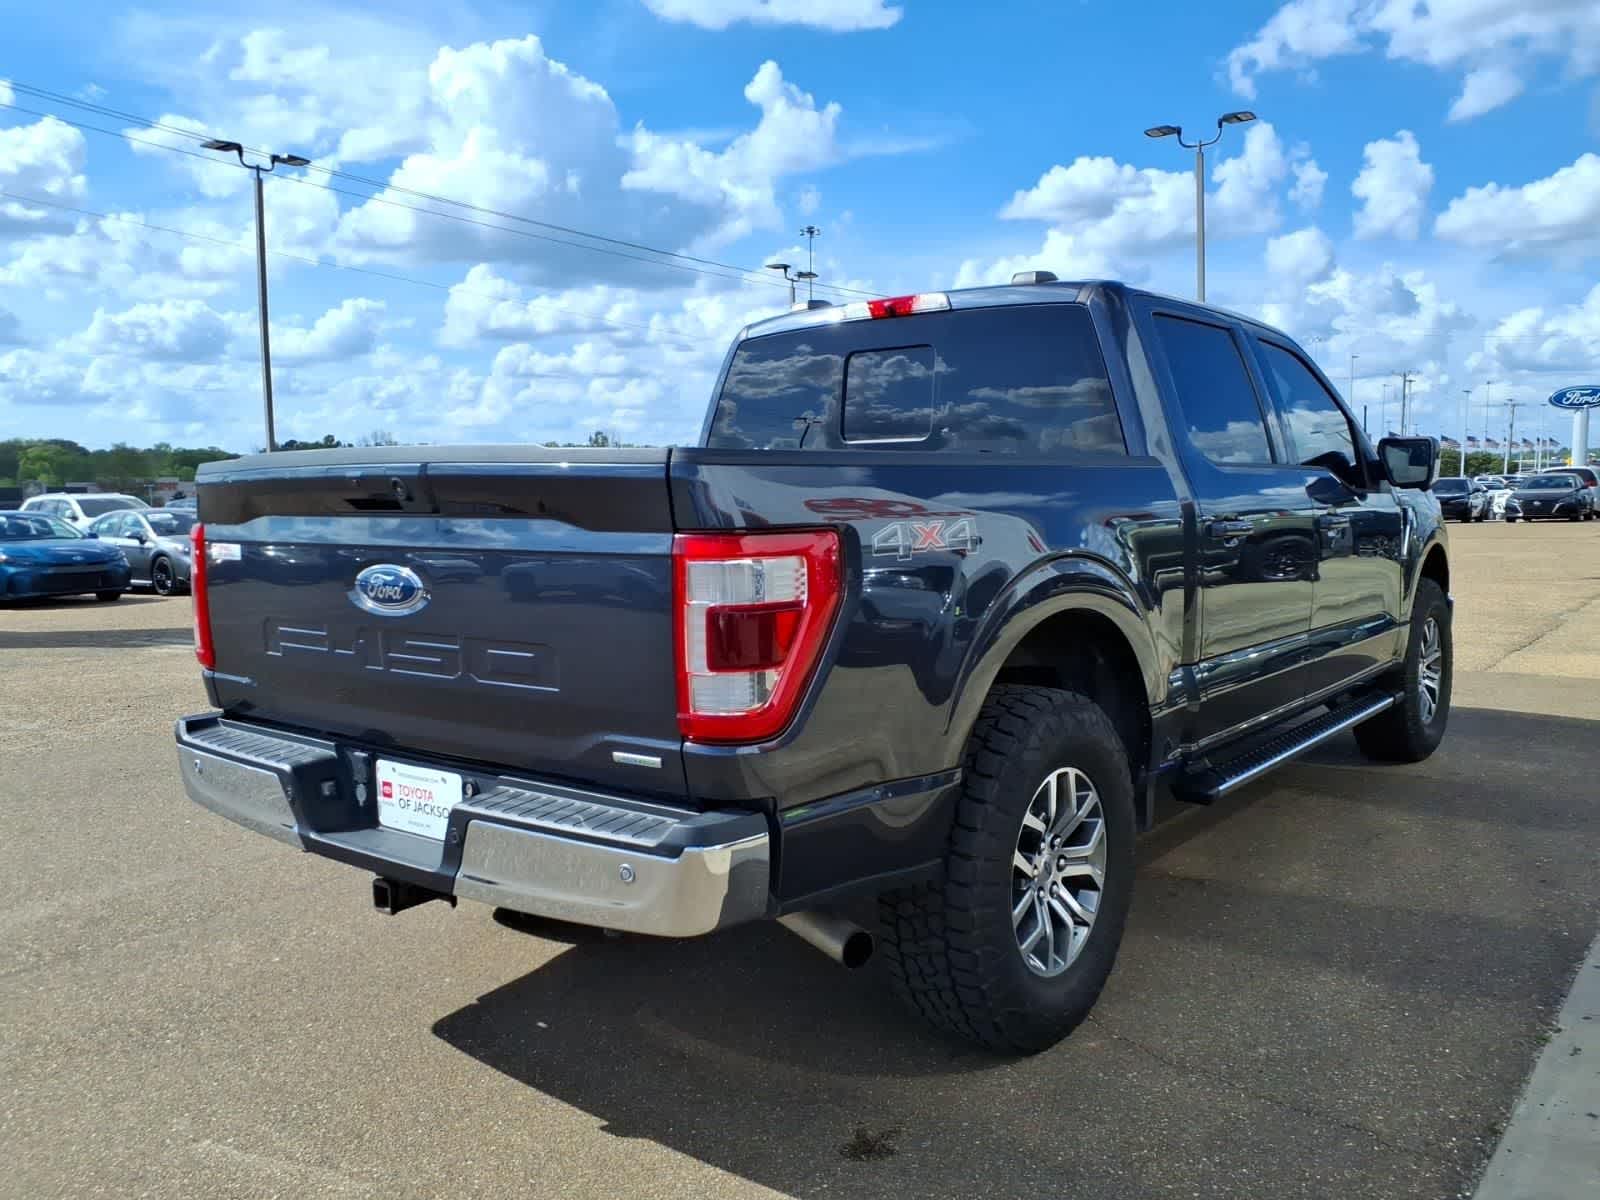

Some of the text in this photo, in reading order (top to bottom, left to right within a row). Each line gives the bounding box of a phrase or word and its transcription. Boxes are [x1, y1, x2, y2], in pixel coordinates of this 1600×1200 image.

[1562, 389, 1600, 405] Ford
[367, 573, 405, 600] Ford
[263, 617, 560, 692] F-150
[398, 783, 434, 801] TOYOTA
[398, 798, 412, 811] OF
[413, 800, 450, 820] JACKSO
